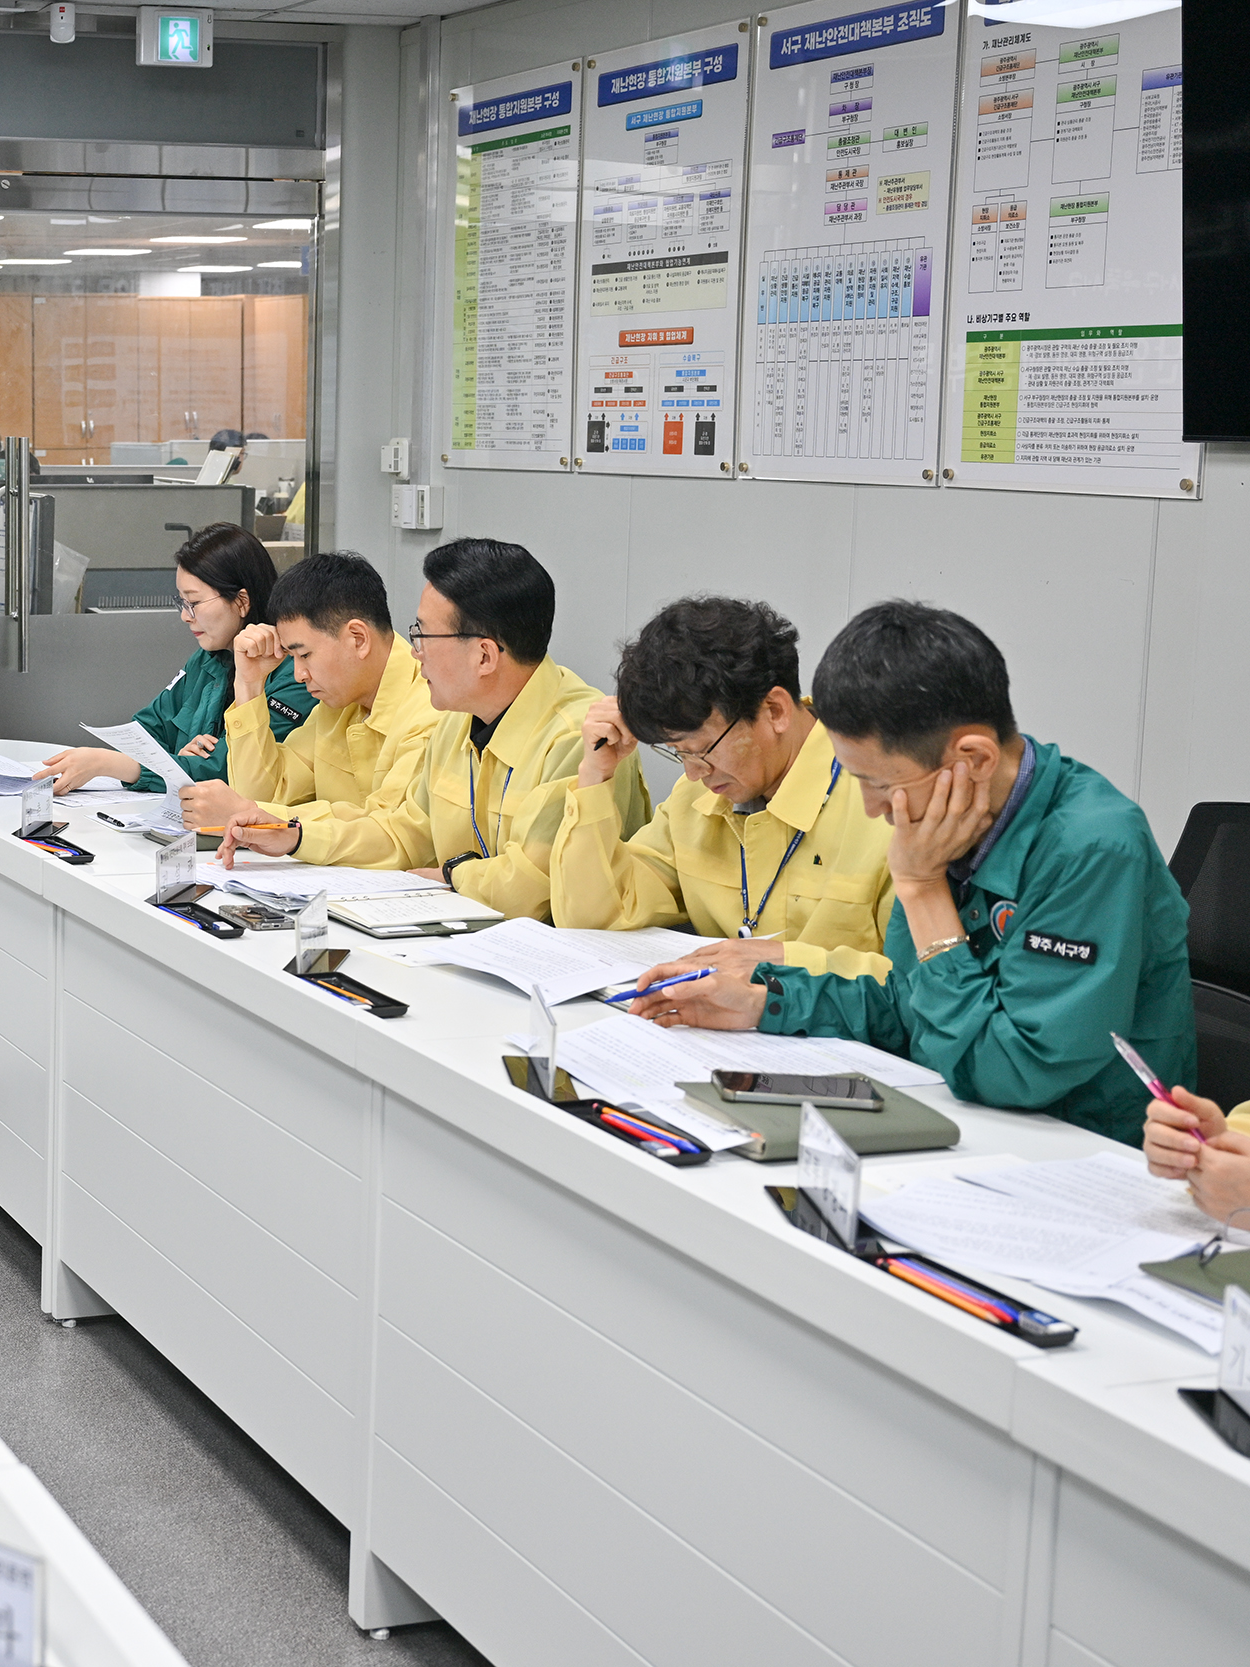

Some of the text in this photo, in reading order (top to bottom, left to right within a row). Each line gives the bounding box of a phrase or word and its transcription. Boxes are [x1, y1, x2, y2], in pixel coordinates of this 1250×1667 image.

[781, 7, 931, 55] 서구 재난안전대책본부 조직도
[992, 33, 1031, 48] 재난관리체계도
[611, 54, 723, 94] 재난현장 통합지원본부 구성
[468, 91, 560, 125] 재난현장 통합지원본부 구성
[631, 115, 642, 125] 서구
[976, 313, 1004, 324] 비상기구별
[1005, 312, 1017, 322] 주요
[1019, 312, 1030, 321] 역할
[625, 333, 646, 343] 재난현장
[1028, 934, 1091, 959] 광주 서구청
